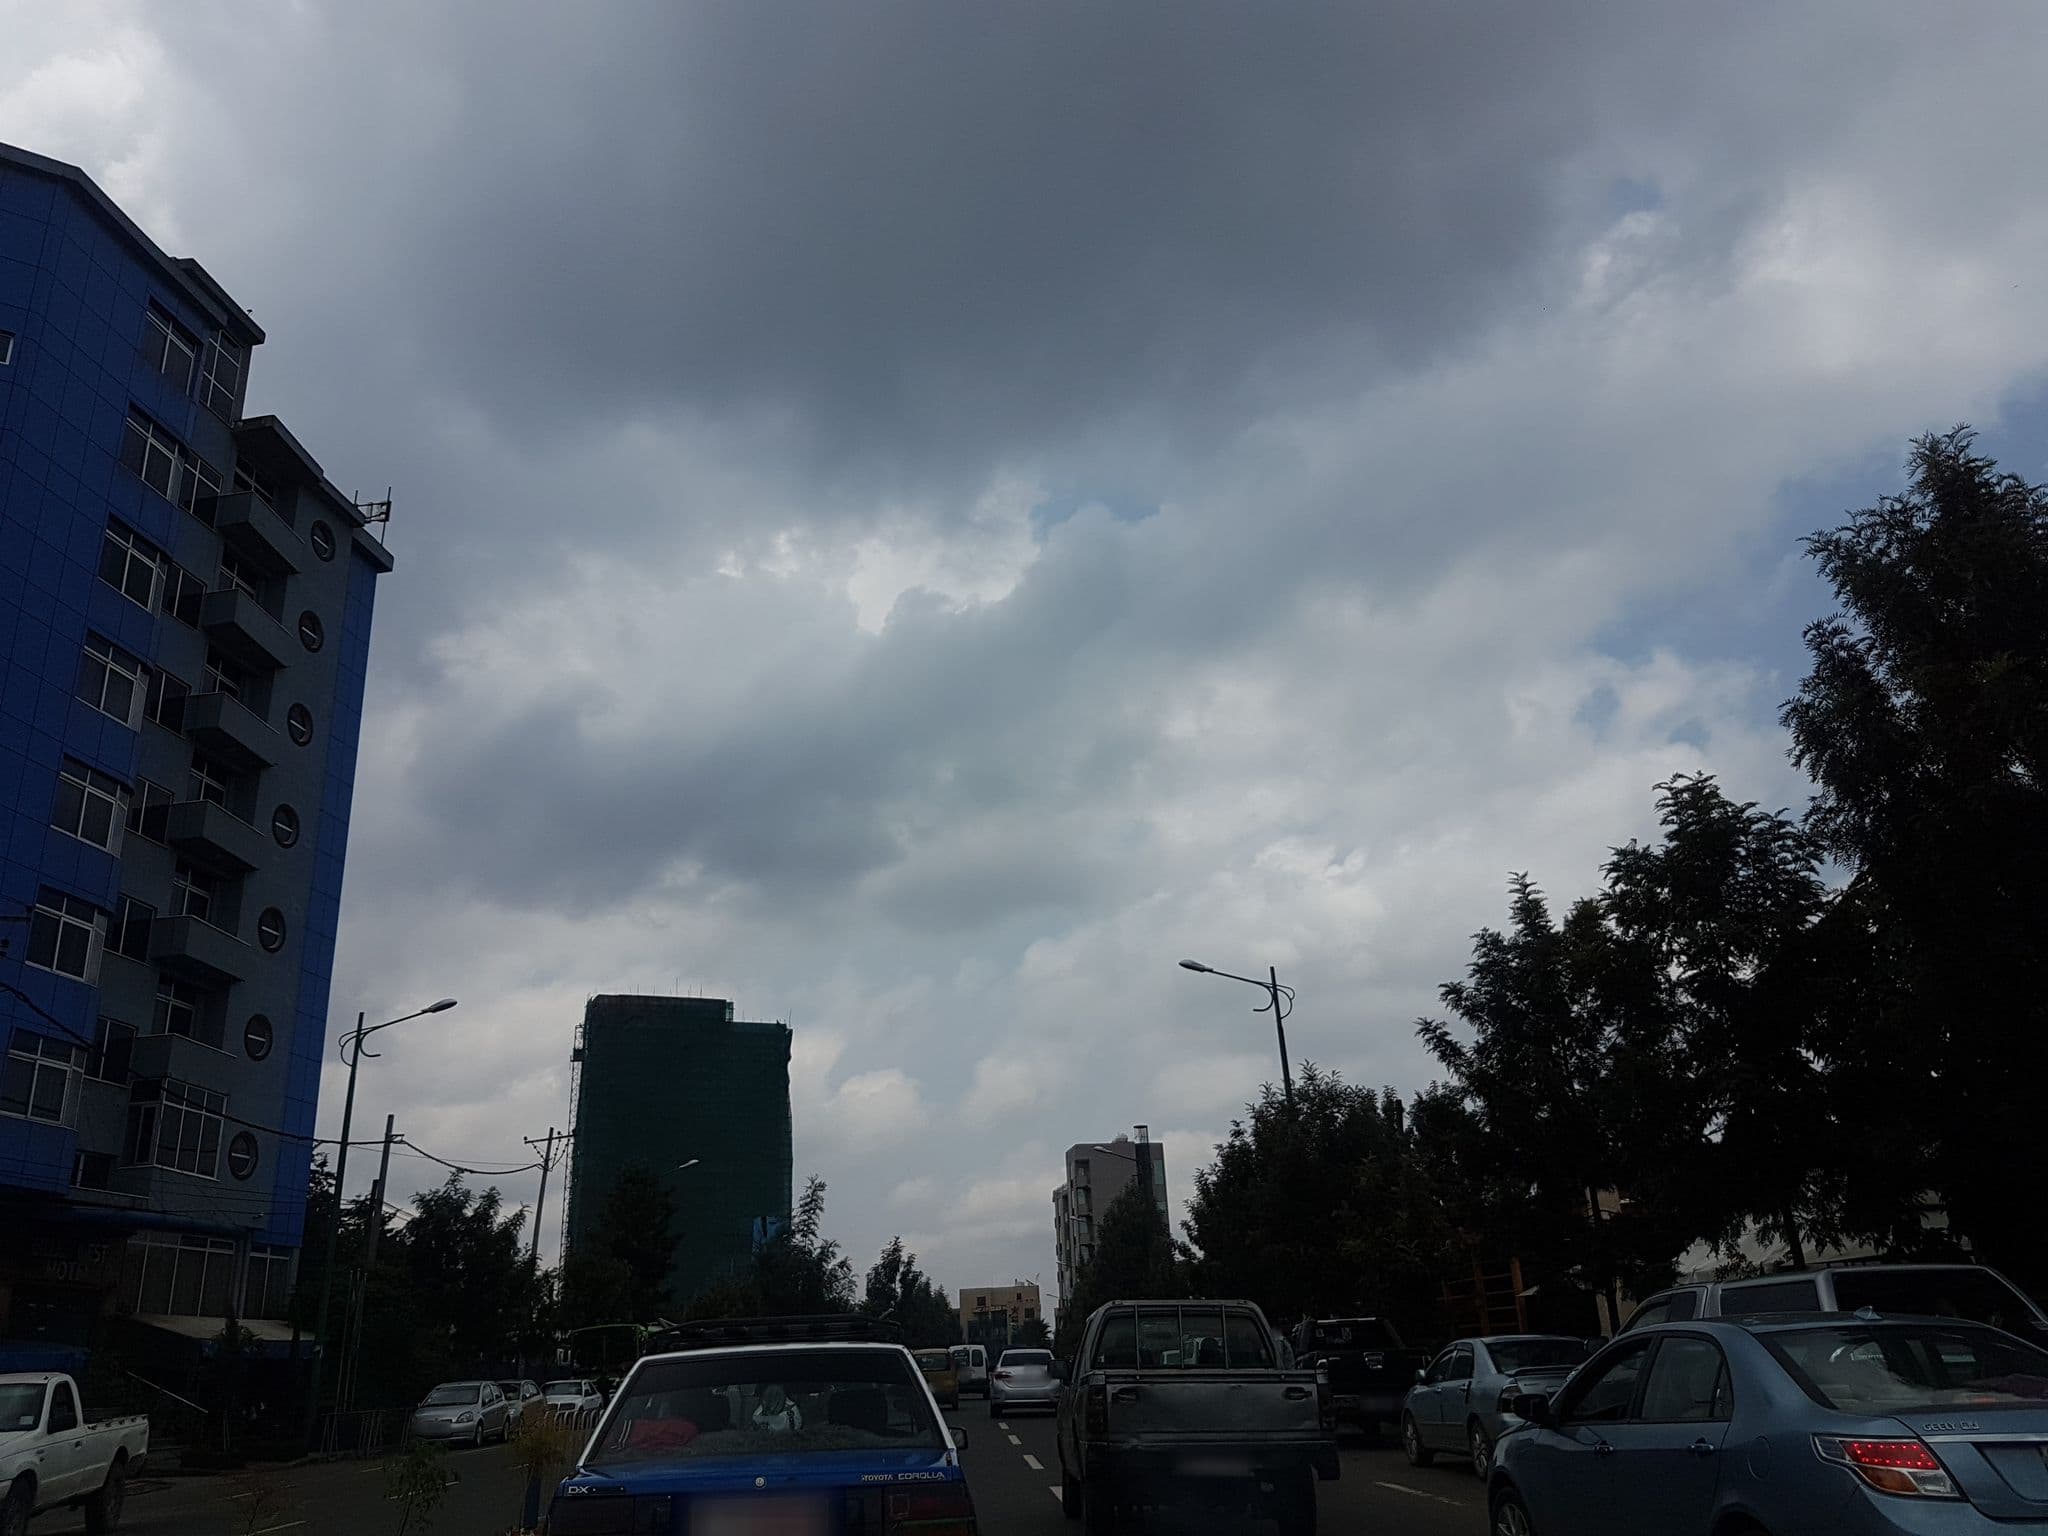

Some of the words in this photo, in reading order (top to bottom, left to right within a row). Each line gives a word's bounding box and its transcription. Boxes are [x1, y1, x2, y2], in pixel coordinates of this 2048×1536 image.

[862, 1473, 894, 1481] TOYOTA
[898, 1471, 945, 1480] COROLLA
[568, 1485, 589, 1494] DX
